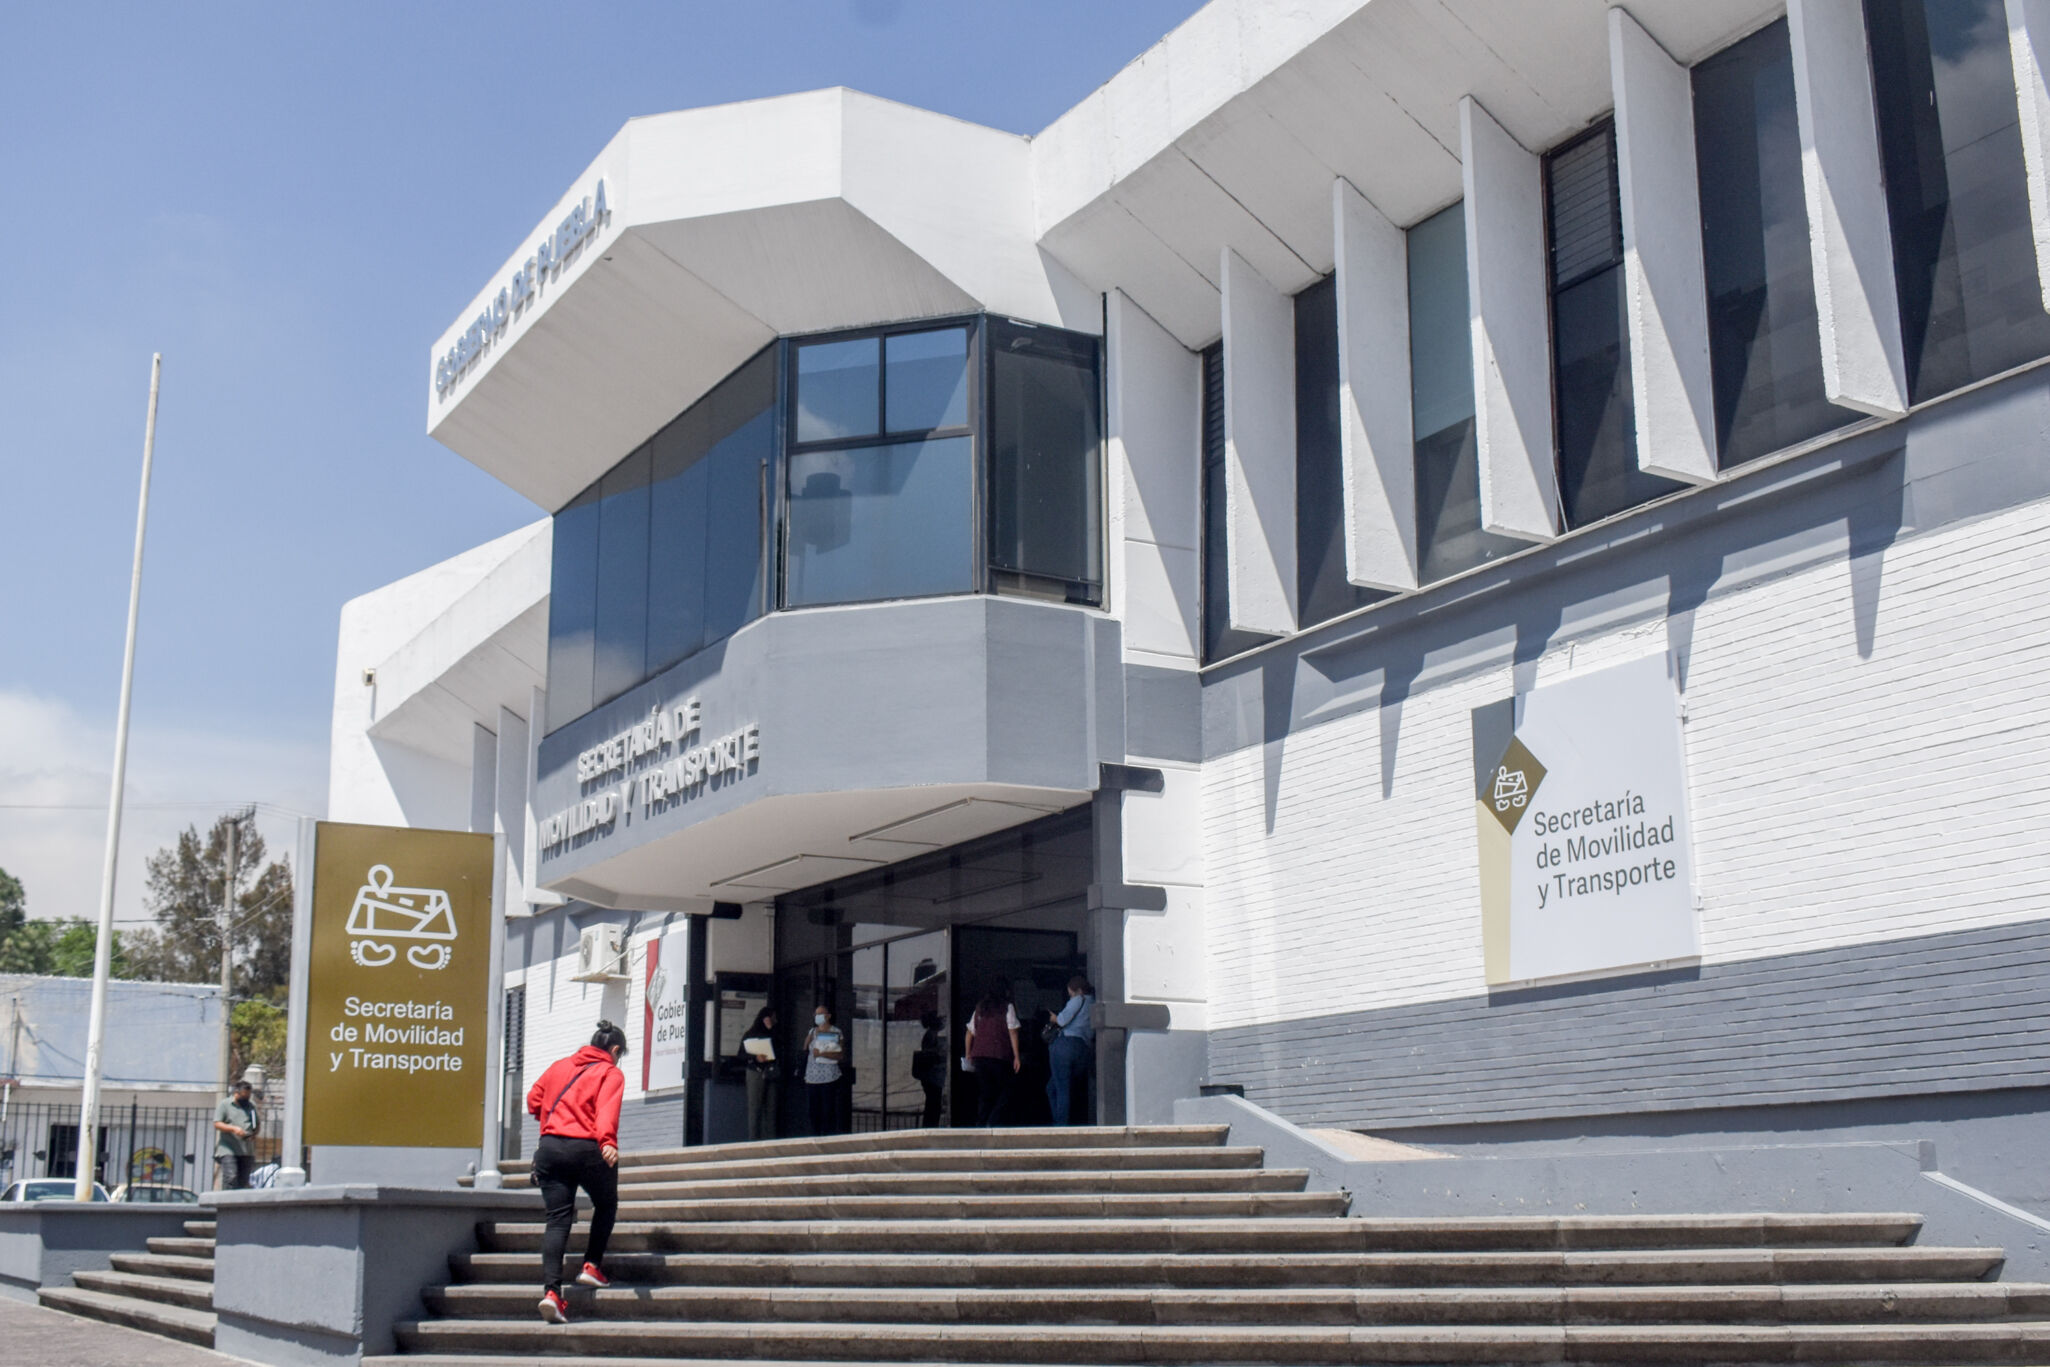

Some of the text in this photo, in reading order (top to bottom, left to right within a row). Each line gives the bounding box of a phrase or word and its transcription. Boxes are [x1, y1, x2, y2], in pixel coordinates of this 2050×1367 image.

[577, 696, 701, 784] SECRETARÍA DE
[539, 722, 760, 850] MOVILIDAD Y TRANSPORTE
[1533, 790, 1645, 837] Secretaría
[1536, 815, 1675, 869] de Movilidad
[1537, 856, 1676, 910] y Transporte
[344, 996, 453, 1021] Secretaría
[330, 1022, 464, 1047] de Movilidad
[656, 1026, 667, 1042] de
[330, 1048, 463, 1075] y Transporte
